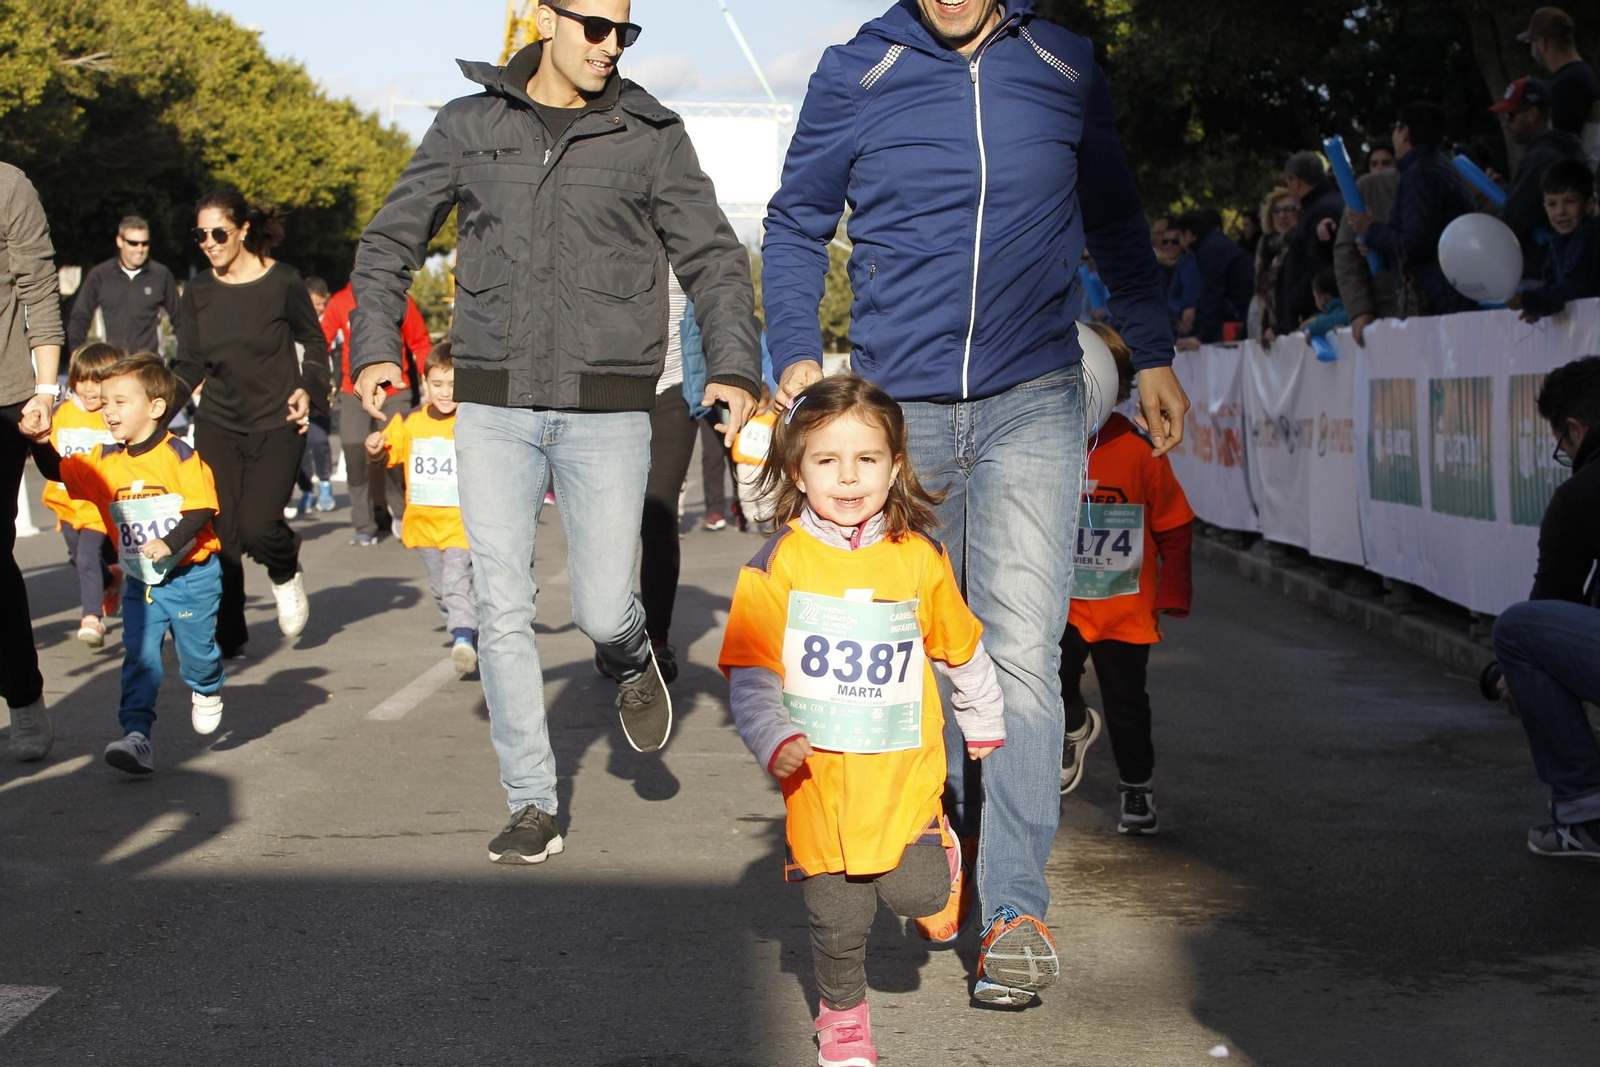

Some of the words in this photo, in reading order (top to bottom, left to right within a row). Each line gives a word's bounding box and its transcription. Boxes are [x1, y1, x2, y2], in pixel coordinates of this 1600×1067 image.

[415, 456, 458, 476] 834
[1105, 558, 1113, 566] T.
[889, 623, 917, 634] INFANTIL
[800, 634, 914, 686] 8387
[837, 684, 883, 698] MARTA
